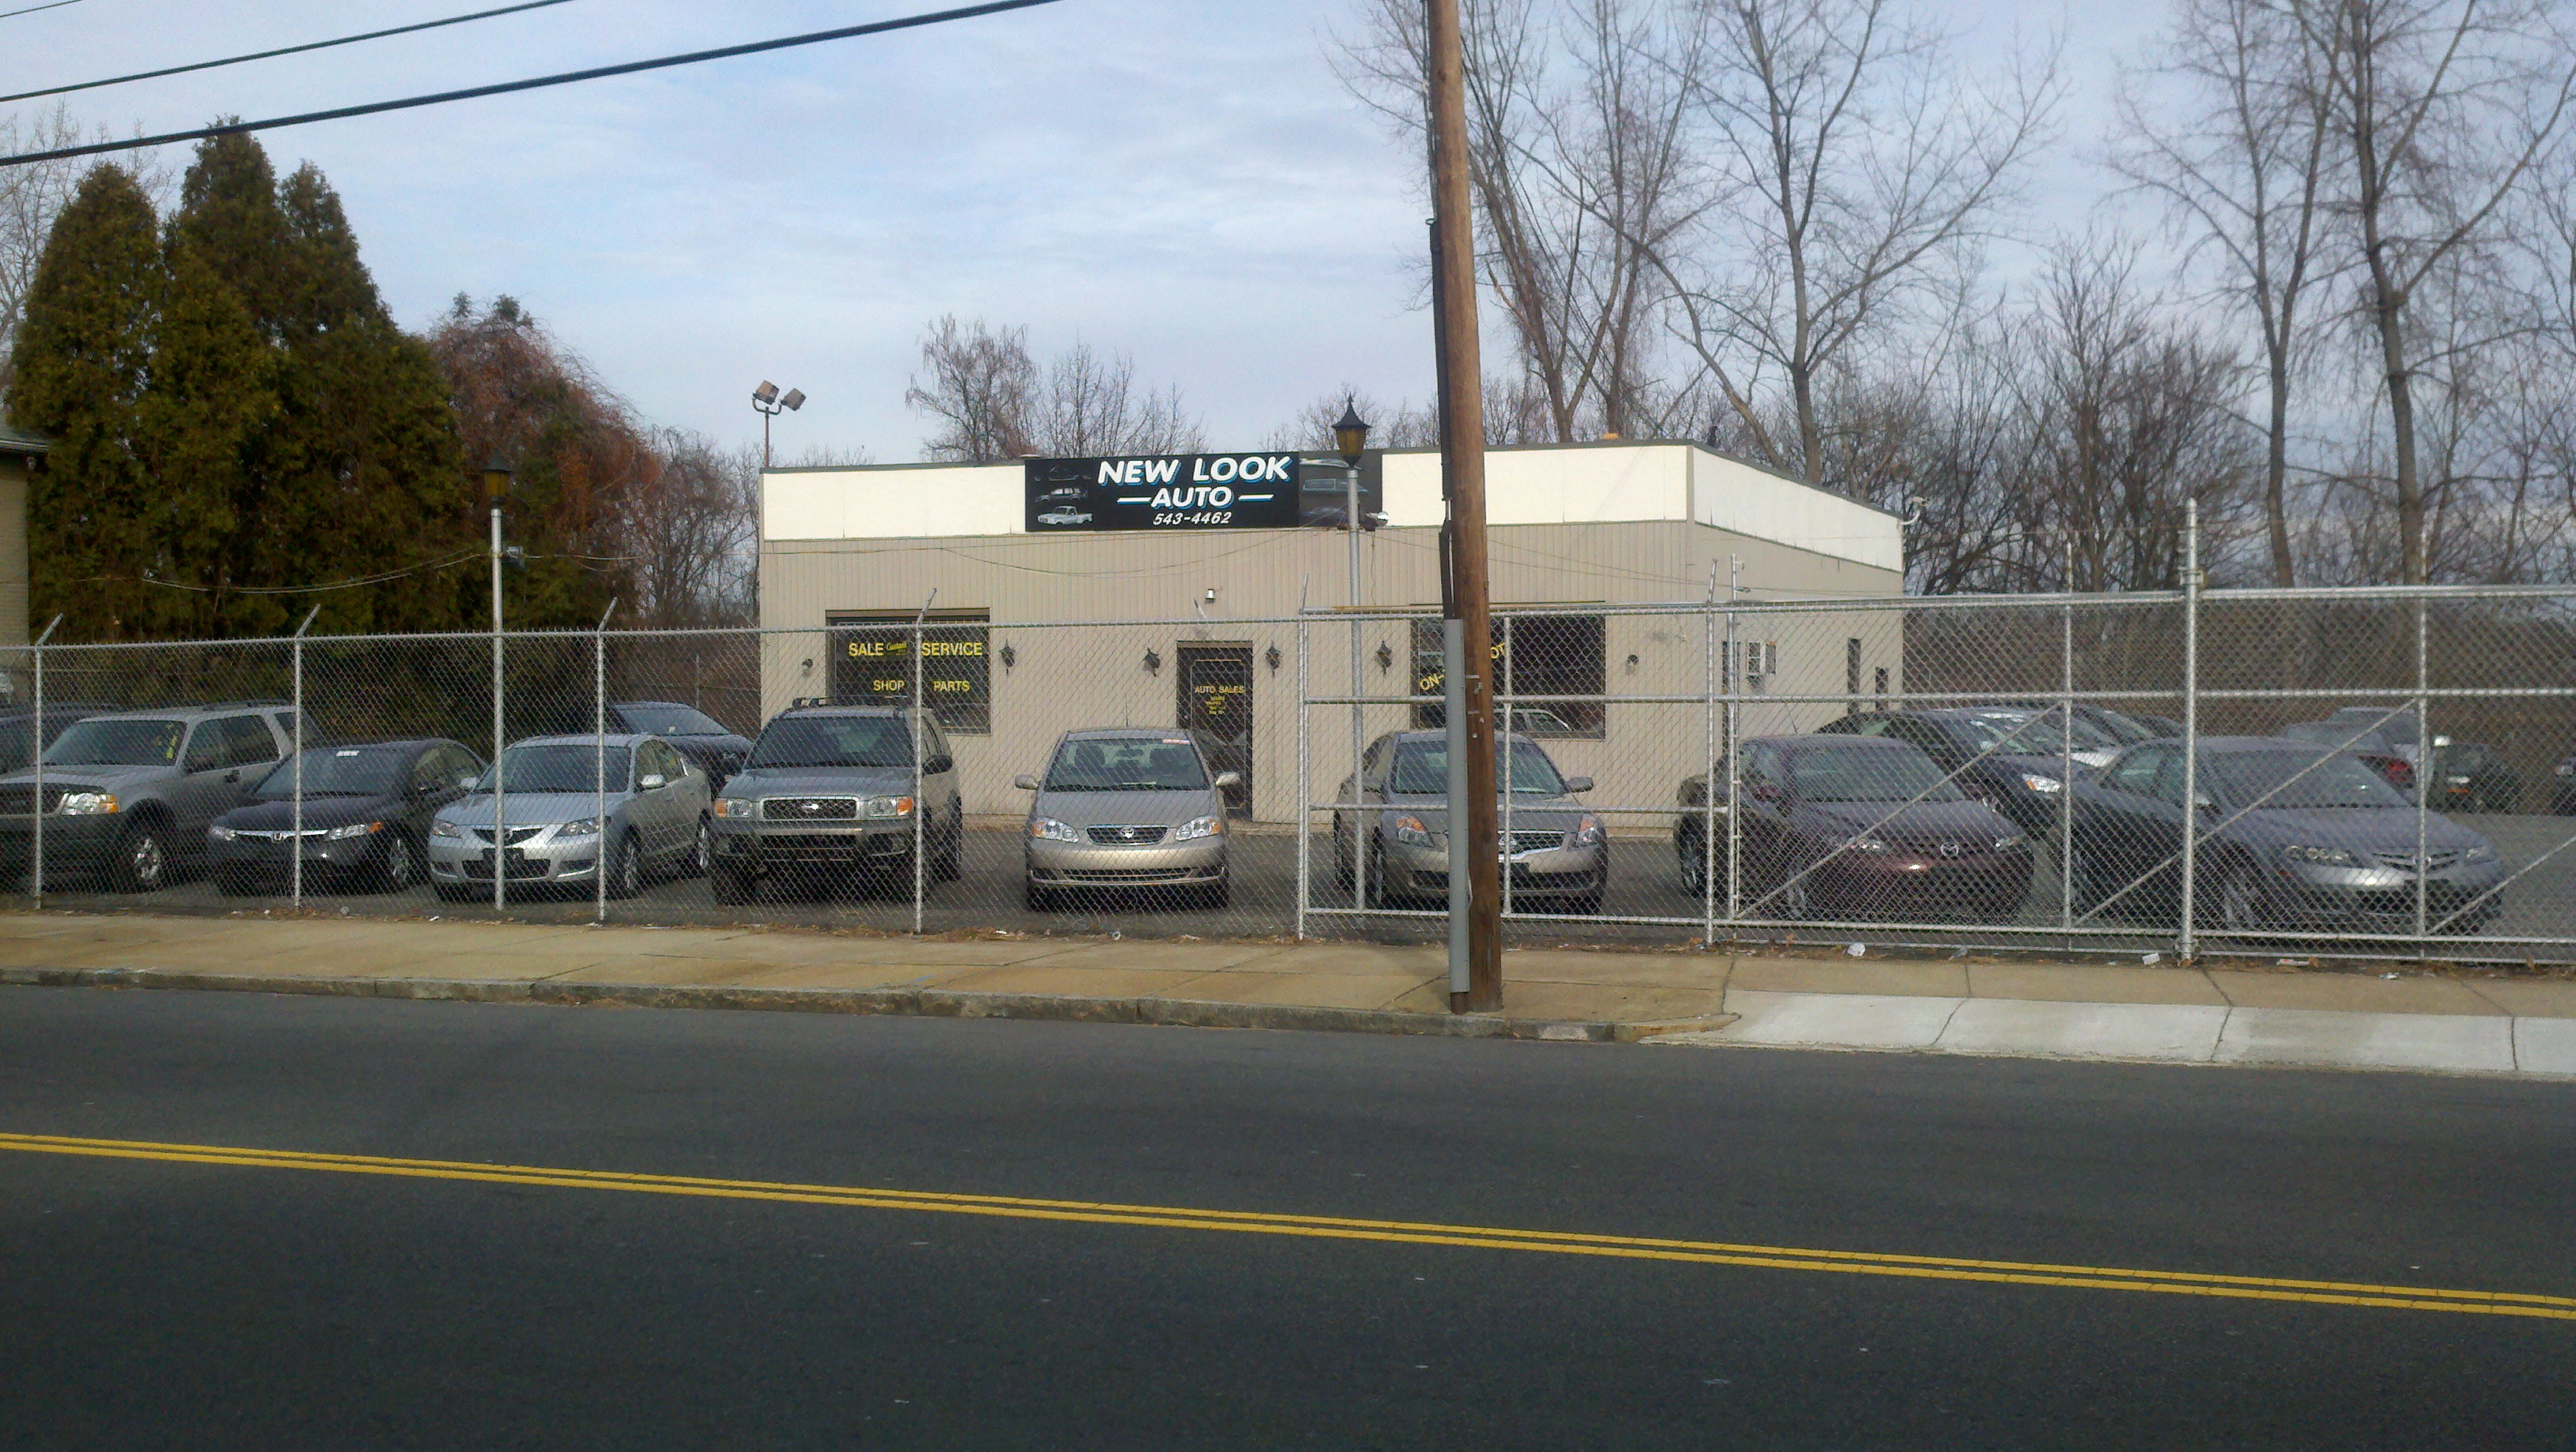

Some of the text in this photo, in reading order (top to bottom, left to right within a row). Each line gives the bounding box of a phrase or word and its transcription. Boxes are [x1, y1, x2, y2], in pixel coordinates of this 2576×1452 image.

[1098, 456, 1292, 485] NEW LOOK
[1150, 487, 1234, 510] AUTO
[1152, 512, 1232, 526] 543-4462
[848, 642, 884, 657] SALE
[922, 642, 983, 657] SERVICE
[873, 679, 971, 692] SHOP PARTS
